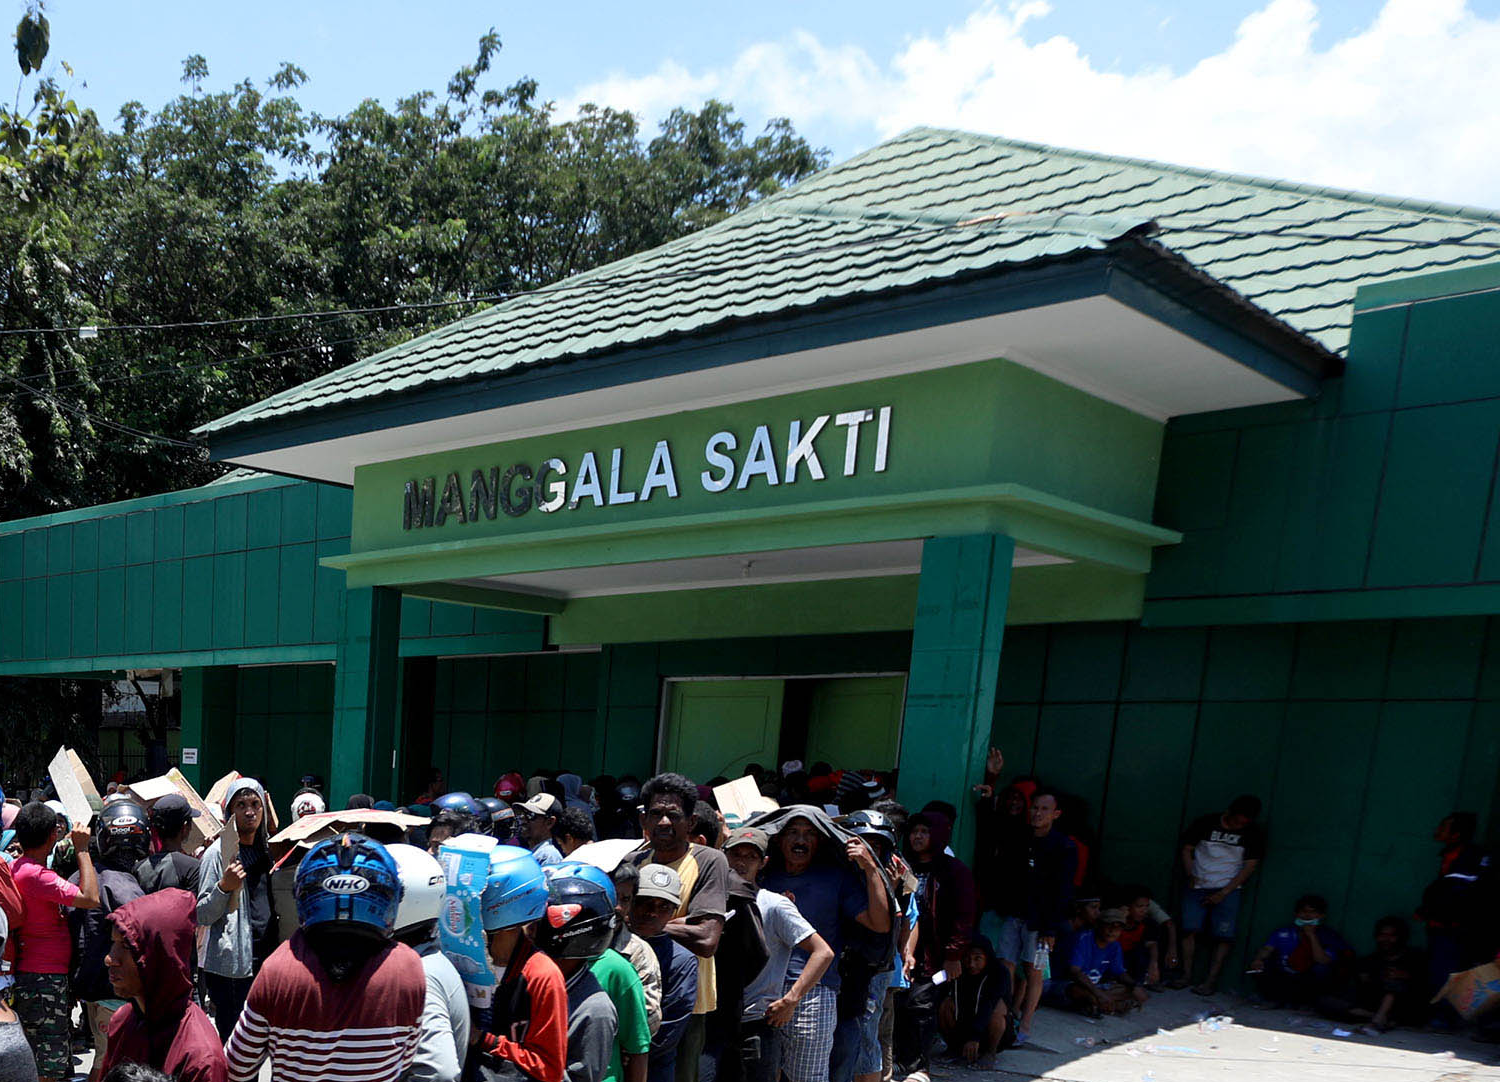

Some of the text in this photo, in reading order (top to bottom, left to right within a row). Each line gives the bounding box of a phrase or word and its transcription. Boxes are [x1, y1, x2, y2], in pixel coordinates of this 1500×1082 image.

[402, 405, 892, 530] MANGGALA SAKTI
[1211, 830, 1241, 845] BLACK
[327, 878, 363, 891] NHK
